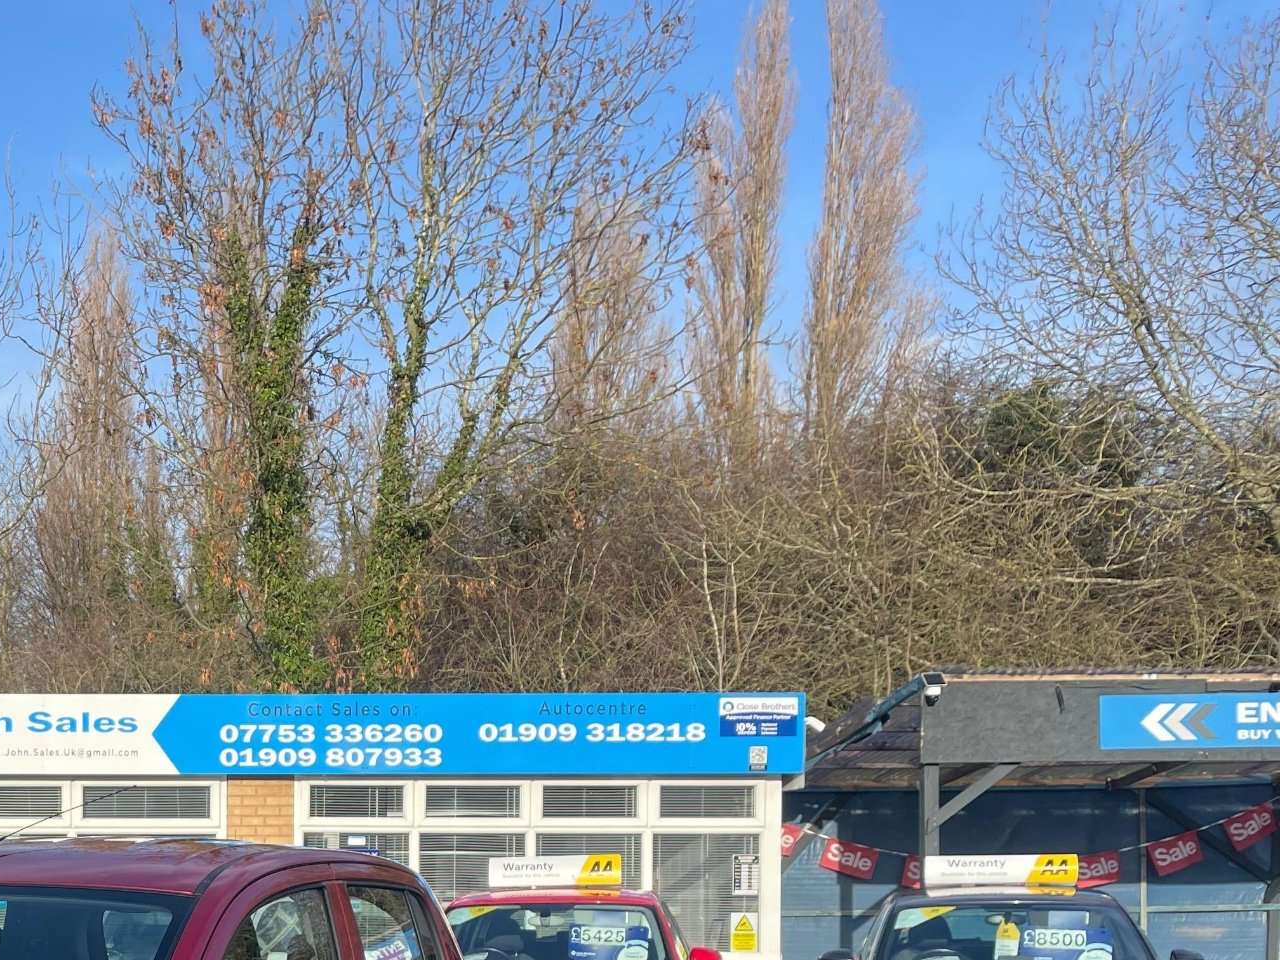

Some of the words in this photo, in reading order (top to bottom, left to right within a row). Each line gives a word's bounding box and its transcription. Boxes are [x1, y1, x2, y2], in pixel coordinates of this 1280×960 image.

[248, 702, 322, 717] Contact
[332, 702, 381, 717] Sales
[538, 700, 648, 716] Autocentre
[1237, 702, 1280, 723] EN
[27, 711, 138, 733] Sales
[219, 724, 316, 743] 07753
[324, 724, 443, 743] 336260
[478, 723, 577, 743] 01909
[585, 723, 706, 743] 318218
[1237, 729, 1273, 740] BUY
[219, 748, 317, 767] 01909
[325, 748, 443, 767] 807933
[1230, 811, 1271, 841] Sale
[827, 843, 873, 871] Sale
[1154, 839, 1197, 866] Sale
[503, 862, 554, 872] Warranty
[590, 861, 613, 873] AA
[946, 859, 1007, 870] Warranty
[1040, 859, 1069, 875] AA
[1079, 857, 1120, 879] Sale
[571, 927, 625, 943] £5425
[1023, 929, 1086, 946] £8500
